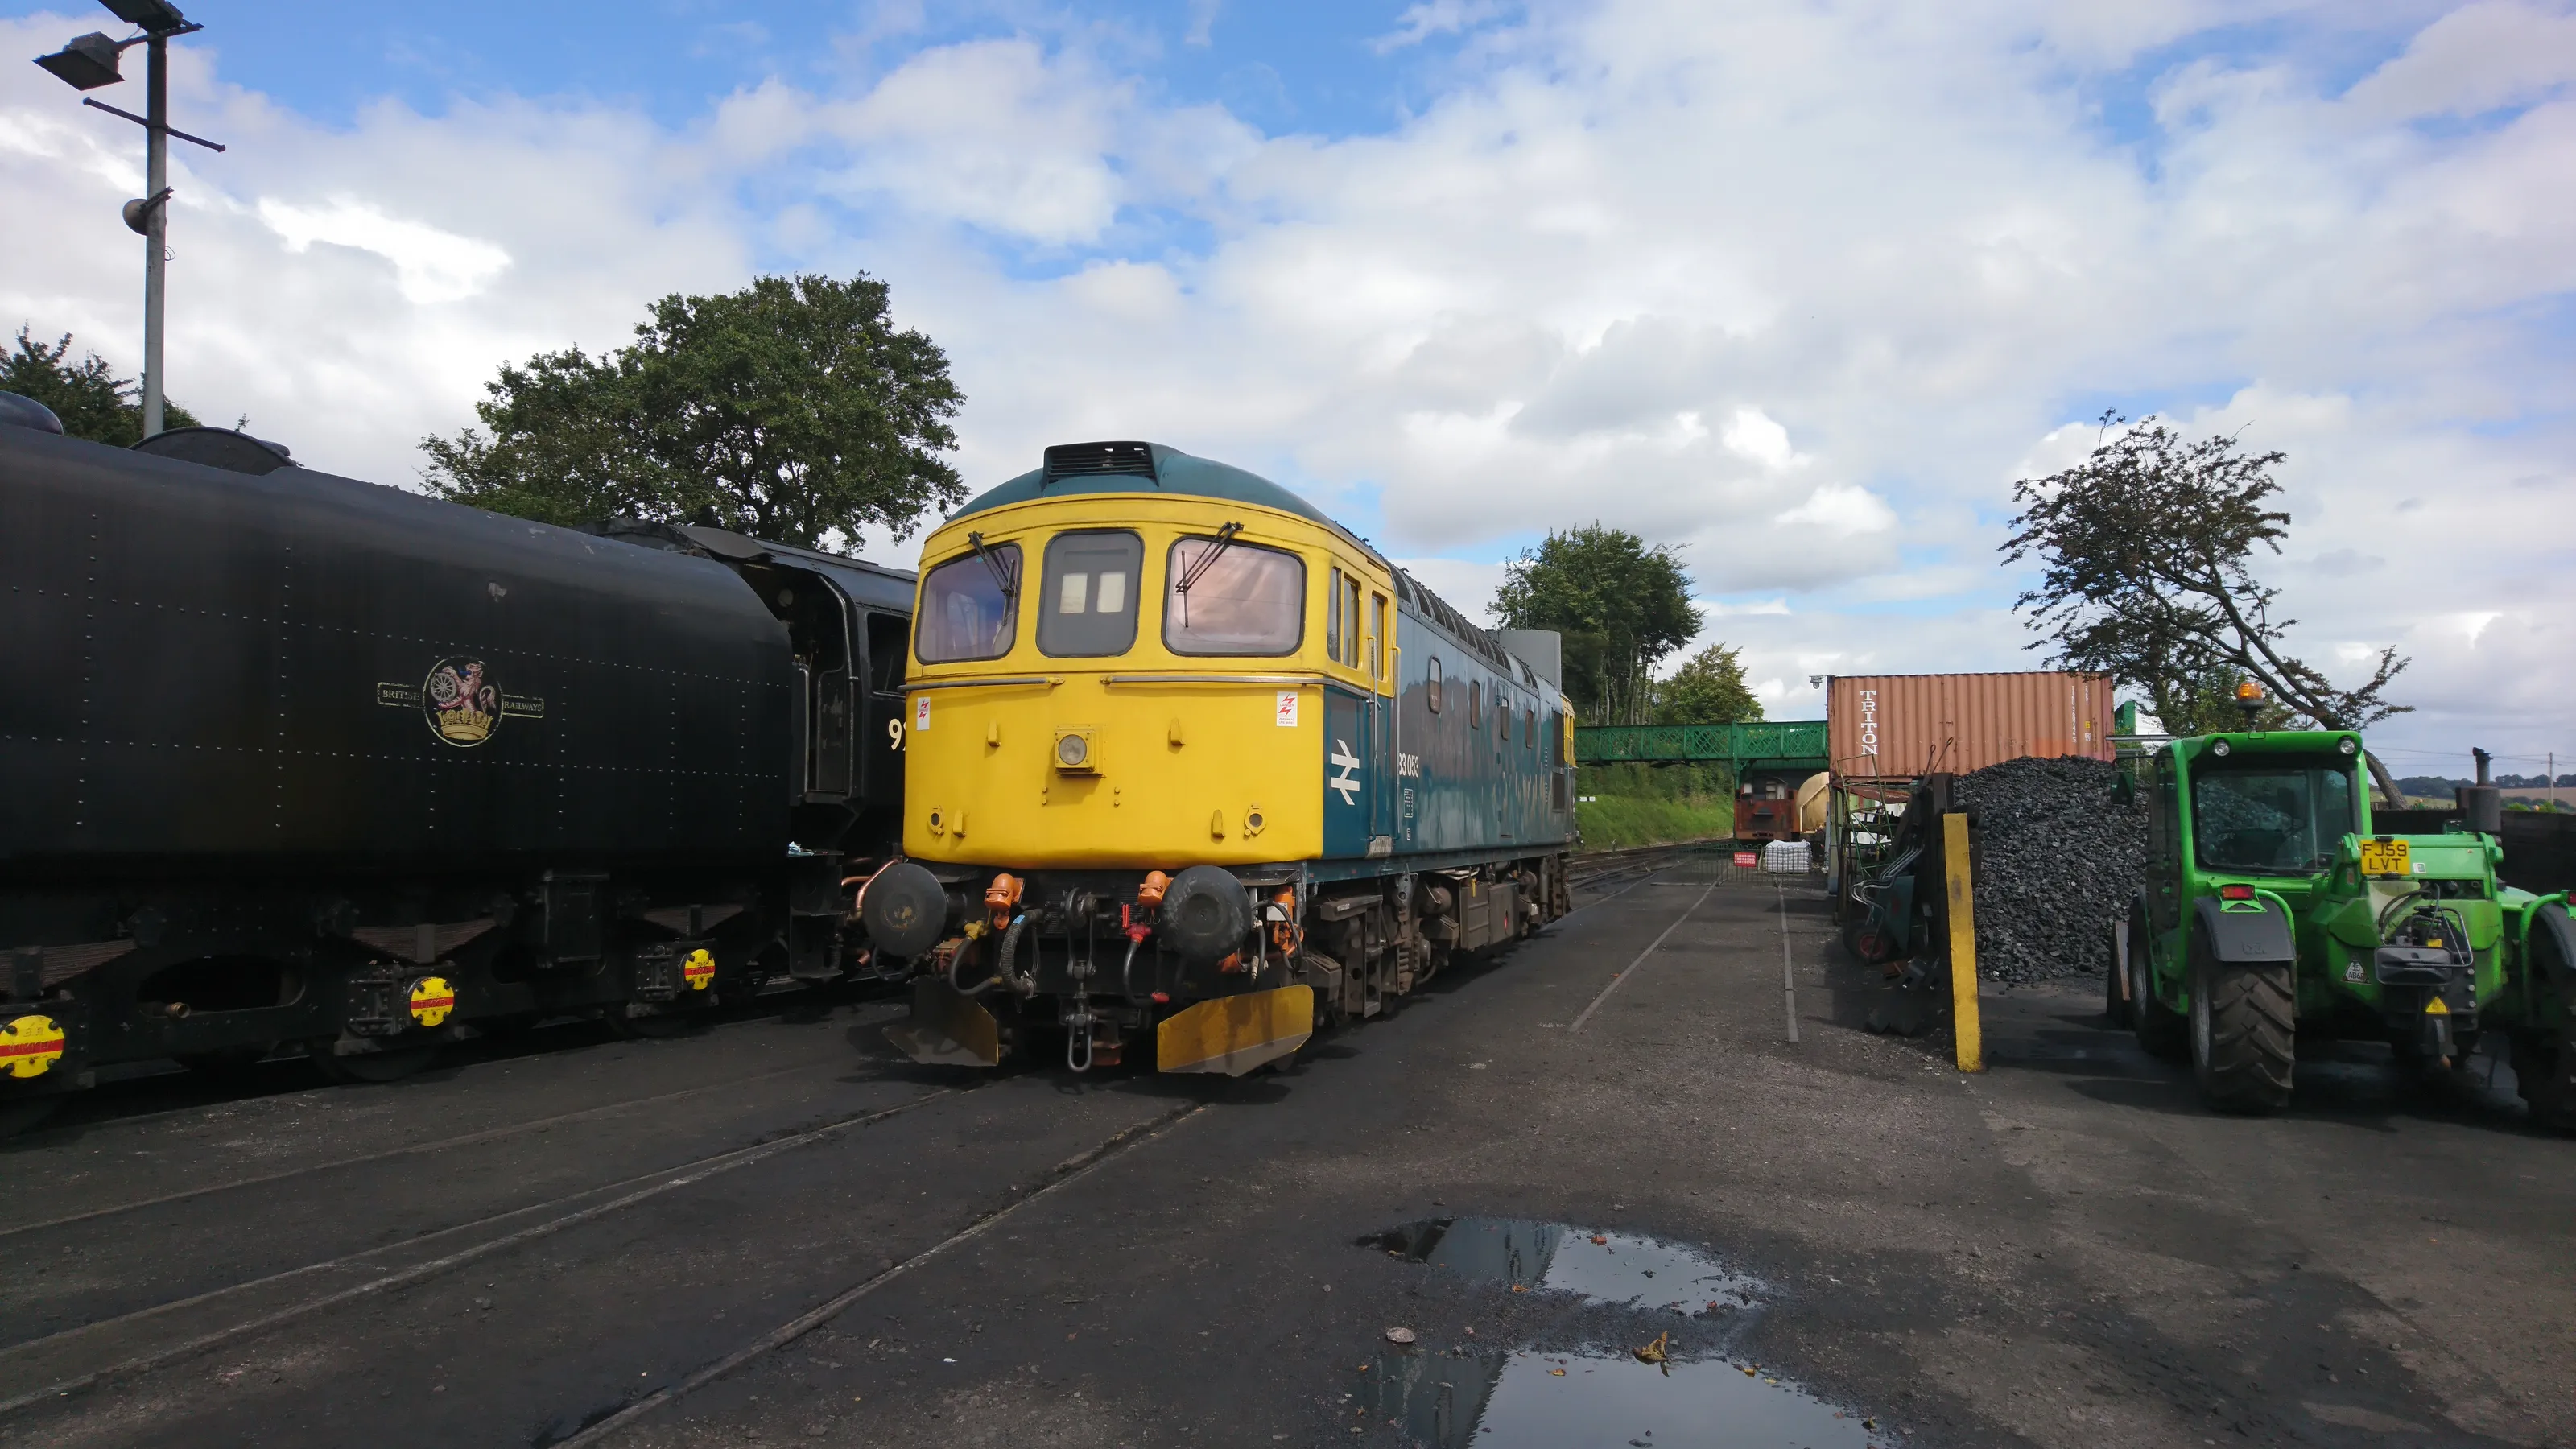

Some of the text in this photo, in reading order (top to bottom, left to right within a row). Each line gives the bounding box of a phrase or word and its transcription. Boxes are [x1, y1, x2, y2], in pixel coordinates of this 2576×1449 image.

[1860, 690, 1878, 755] TRITON
[1406, 754, 1419, 778] 053
[2363, 844, 2408, 857] FJ59
[2369, 858, 2402, 871] LVT
